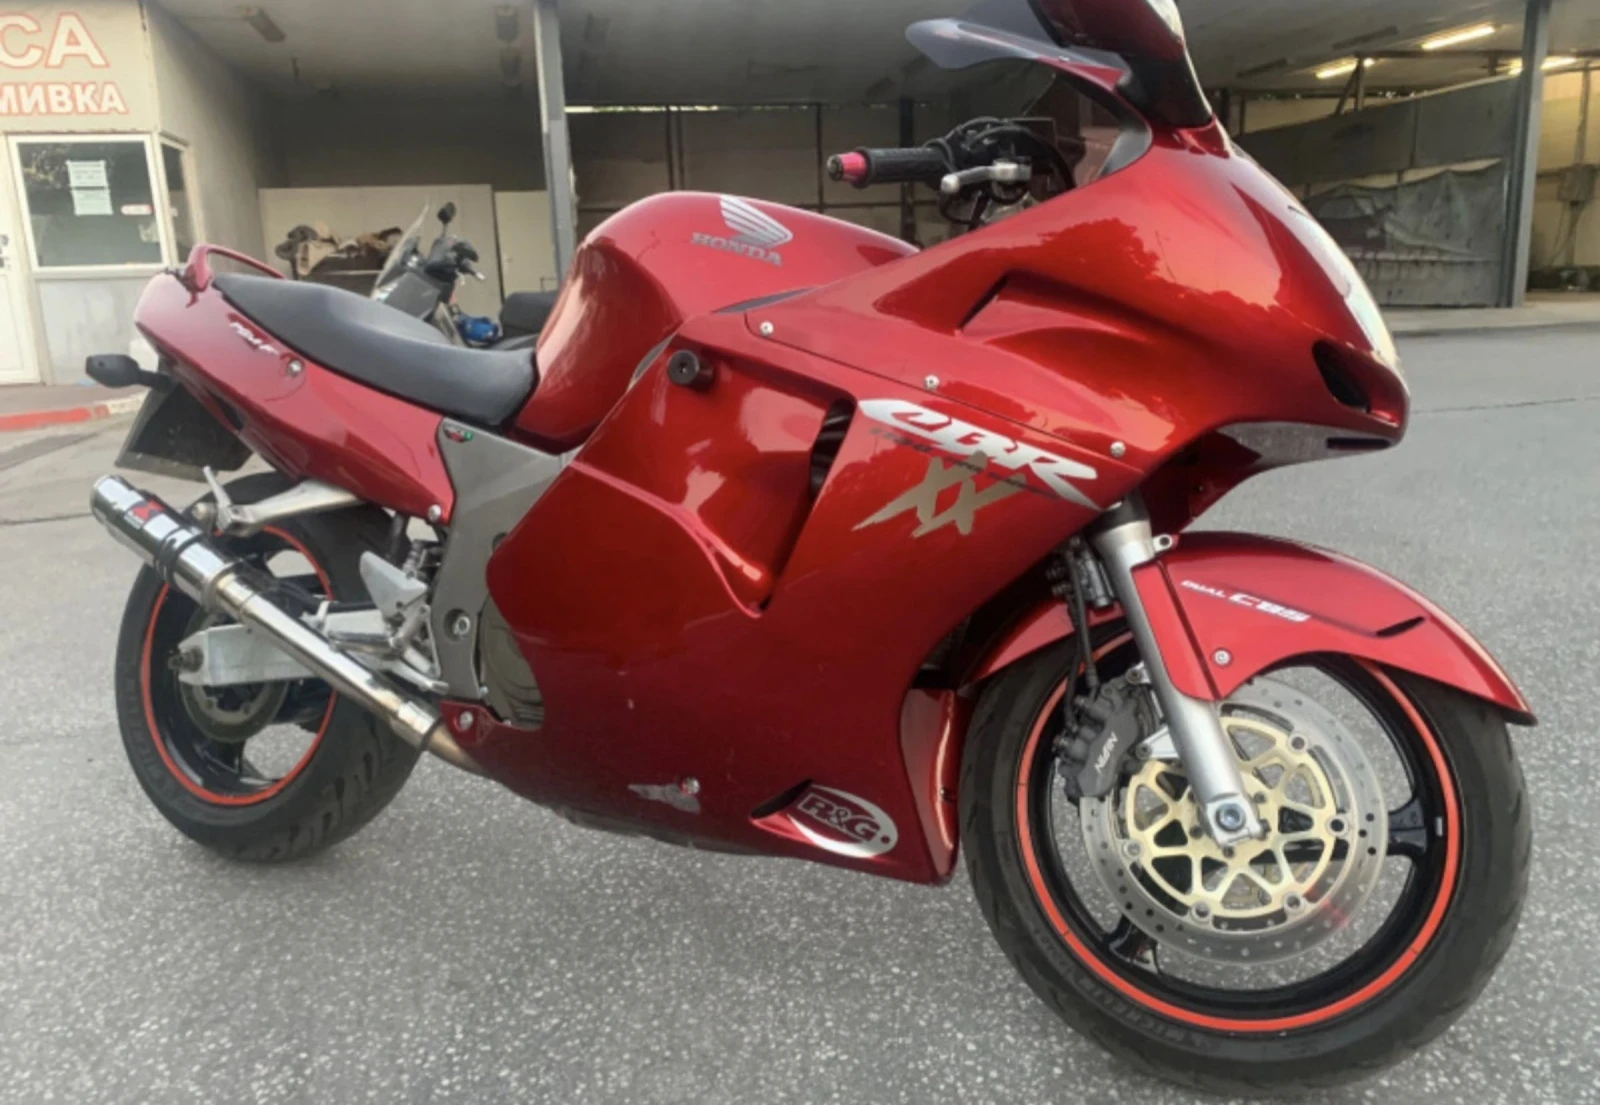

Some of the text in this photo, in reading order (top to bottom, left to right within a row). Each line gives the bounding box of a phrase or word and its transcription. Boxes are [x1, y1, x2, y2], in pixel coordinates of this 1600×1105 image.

[690, 231, 782, 267] HONDA
[851, 449, 1027, 538] XX
[857, 398, 1103, 512] CBR
